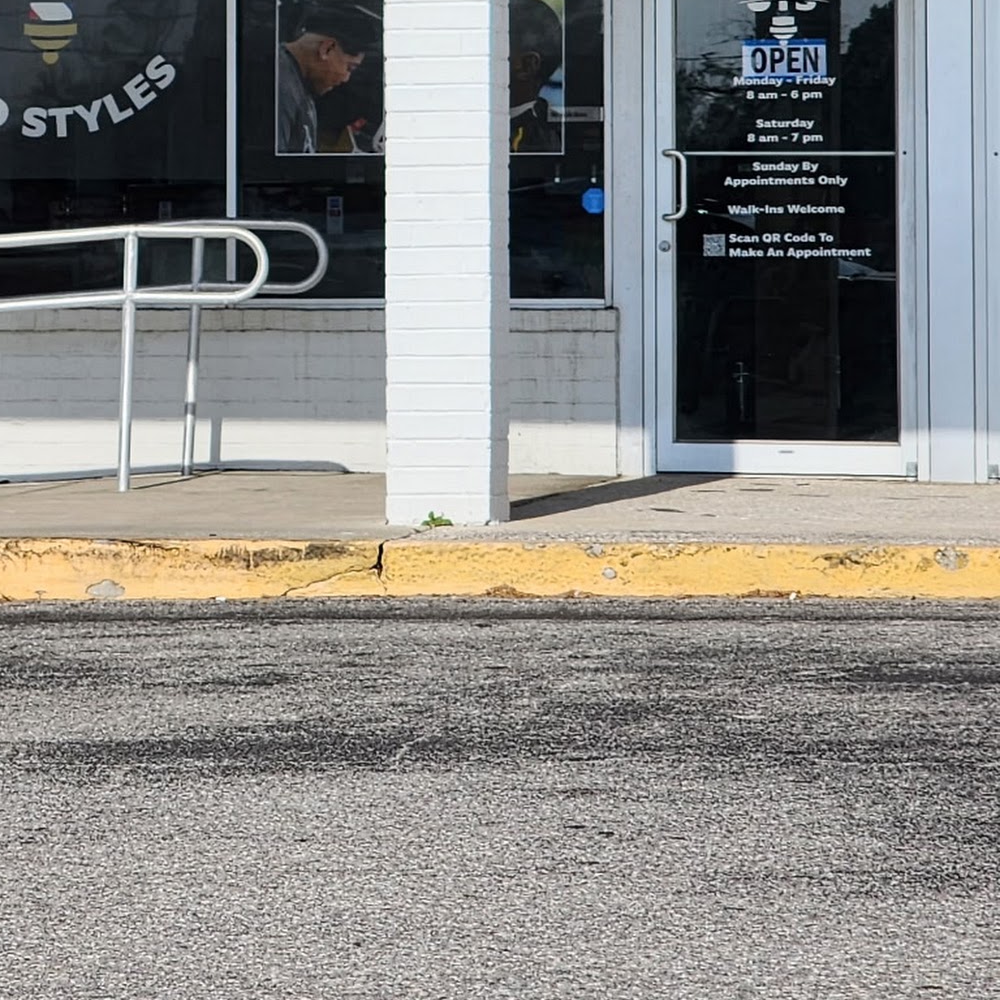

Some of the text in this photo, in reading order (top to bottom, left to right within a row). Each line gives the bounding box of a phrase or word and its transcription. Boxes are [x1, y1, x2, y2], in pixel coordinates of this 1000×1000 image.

[751, 47, 819, 73] OPEN
[732, 76, 784, 88] Monday
[794, 74, 836, 87] Friday
[21, 55, 177, 138] STYLES
[746, 90, 755, 100] 8
[757, 92, 778, 100] am
[790, 89, 799, 99] 6
[801, 91, 823, 101] pm
[755, 118, 815, 130] Saturday
[747, 133, 756, 143] 8
[758, 135, 779, 143] am
[791, 132, 799, 142] 7
[802, 134, 824, 144] pm
[752, 161, 819, 173] Sunday By
[724, 175, 848, 188] Appointments Only
[727, 204, 845, 215] Walk-Ins Welcome
[728, 232, 834, 243] Scan QR Code To
[729, 246, 872, 259] Make An Appointment
